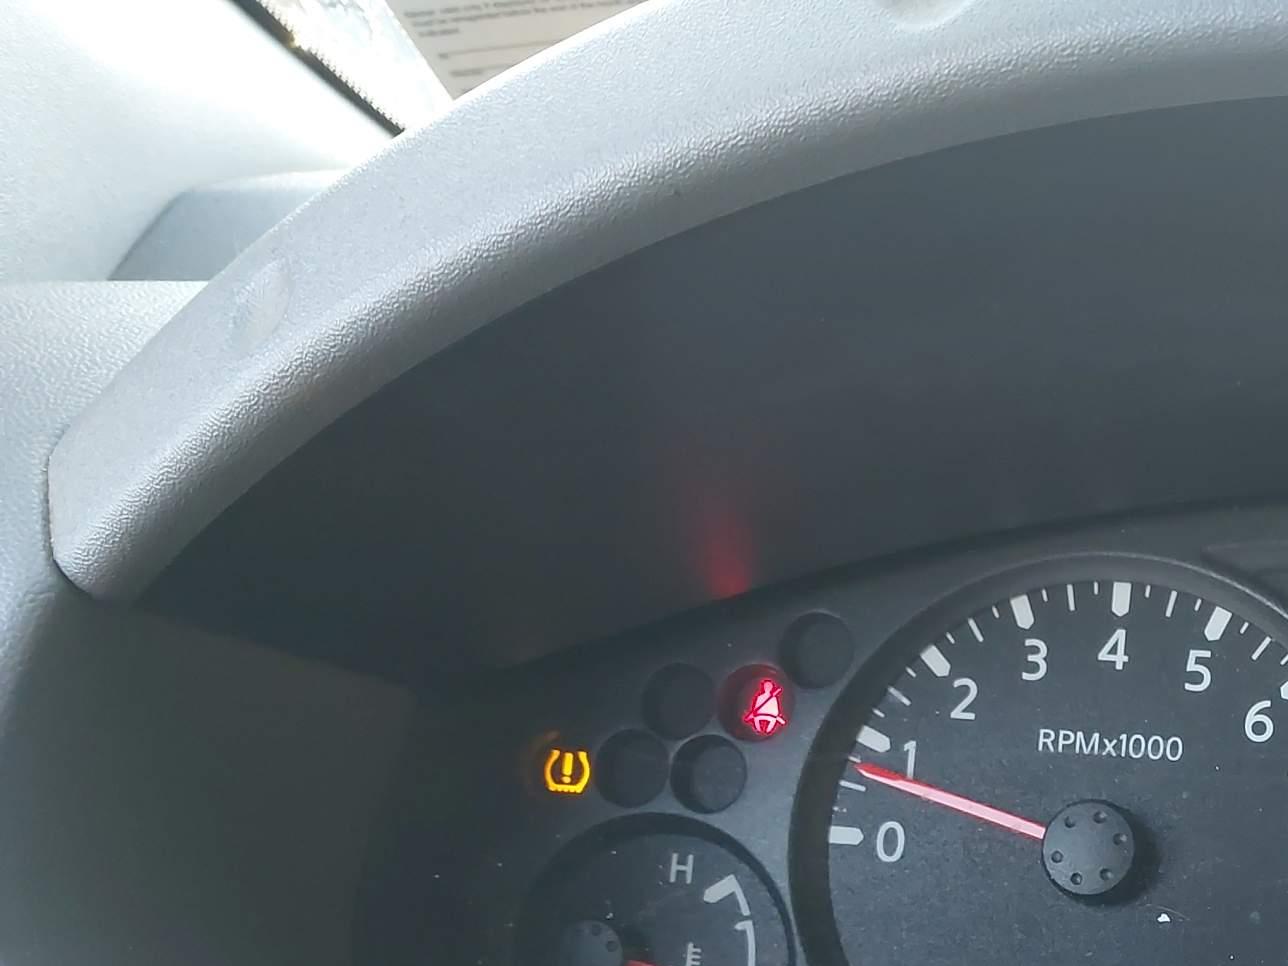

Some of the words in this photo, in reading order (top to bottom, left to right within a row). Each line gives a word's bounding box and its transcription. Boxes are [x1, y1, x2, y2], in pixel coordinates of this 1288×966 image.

[1022, 638, 1048, 681] 3
[1098, 629, 1129, 670] 4
[1185, 650, 1212, 692] 5
[950, 678, 978, 720] 2
[1243, 700, 1274, 743] 6
[903, 740, 919, 779] 1
[875, 821, 905, 863] 0
[669, 853, 694, 884] H
